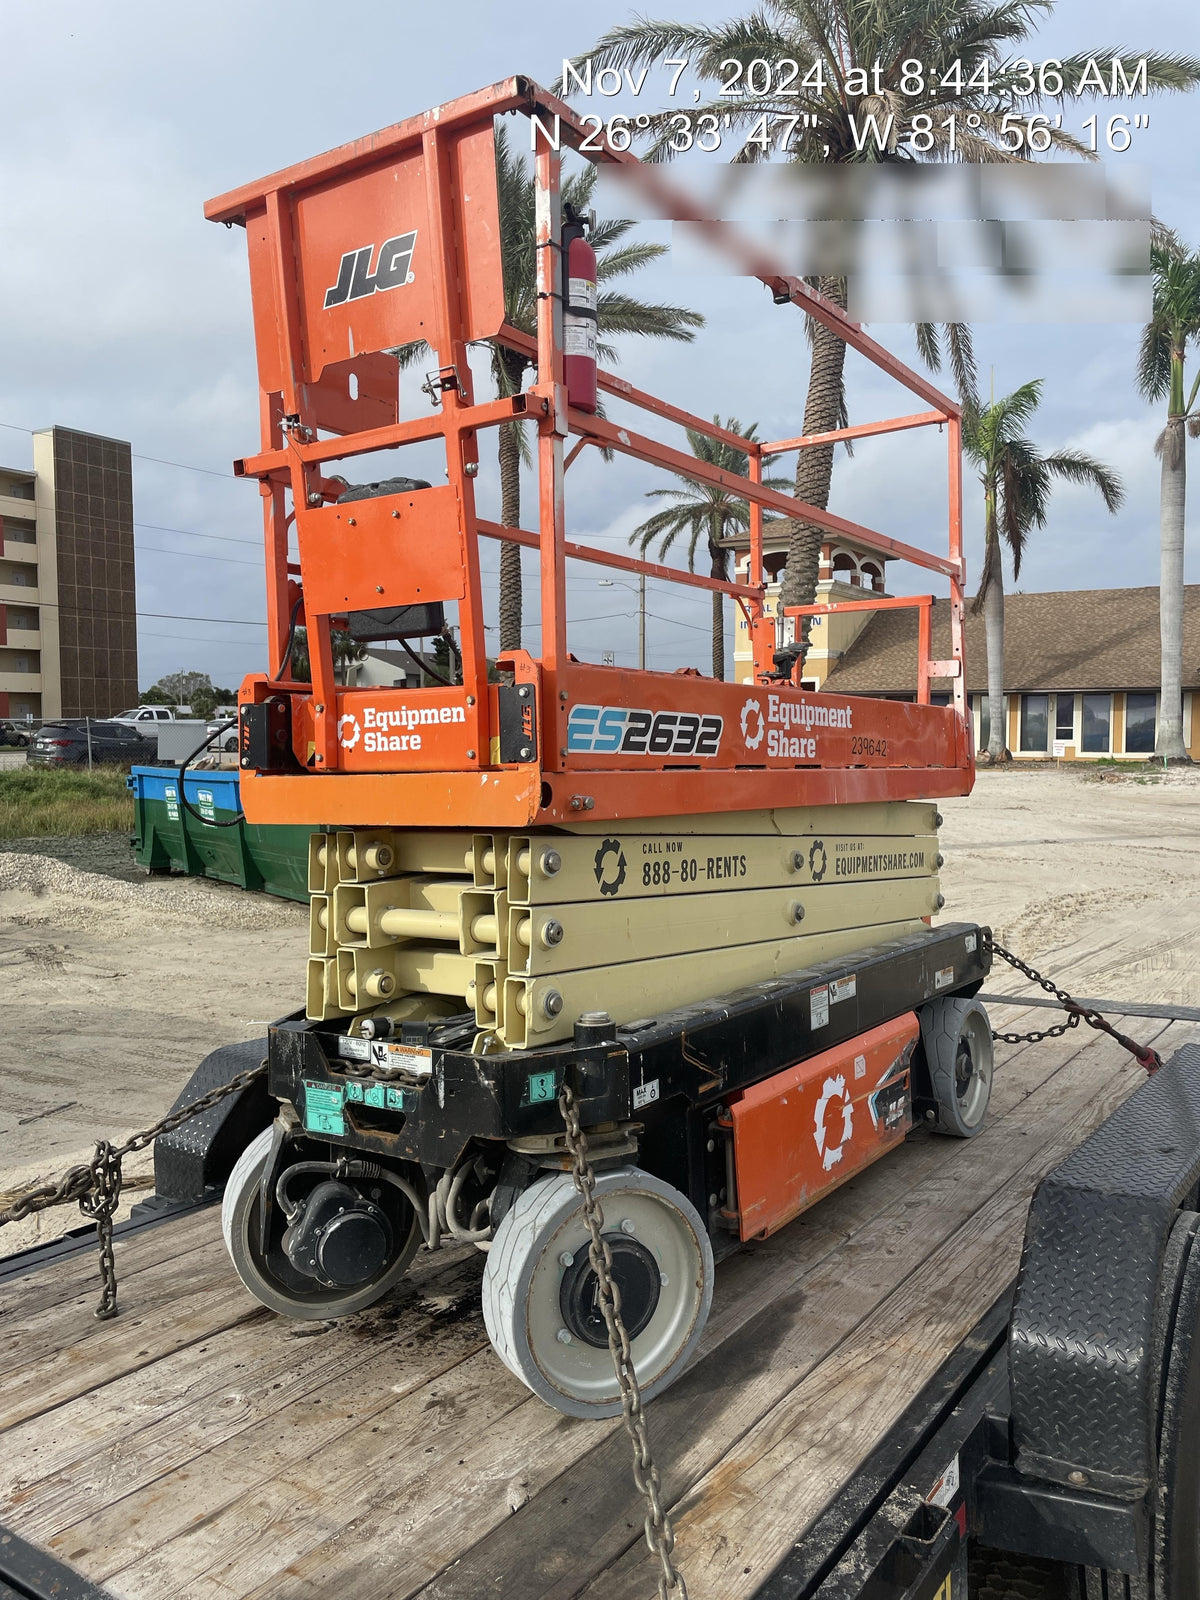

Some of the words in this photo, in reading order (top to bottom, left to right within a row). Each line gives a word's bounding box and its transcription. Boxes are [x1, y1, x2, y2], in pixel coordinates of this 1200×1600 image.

[323, 229, 418, 310] JLG
[363, 705, 466, 731] Equipmen
[521, 704, 533, 741] JLG
[767, 695, 853, 732] Equipment
[363, 732, 422, 753] Share
[567, 703, 724, 757] ES2632
[767, 729, 817, 759] Share
[851, 736, 888, 757] 239642
[642, 843, 663, 855] CALL
[665, 841, 684, 853] NOW
[835, 843, 848, 852] VISIT
[850, 842, 856, 851] US
[642, 854, 747, 887] 888-80-RENTS
[835, 851, 925, 876] EQUIPMENTSHARE.COM
